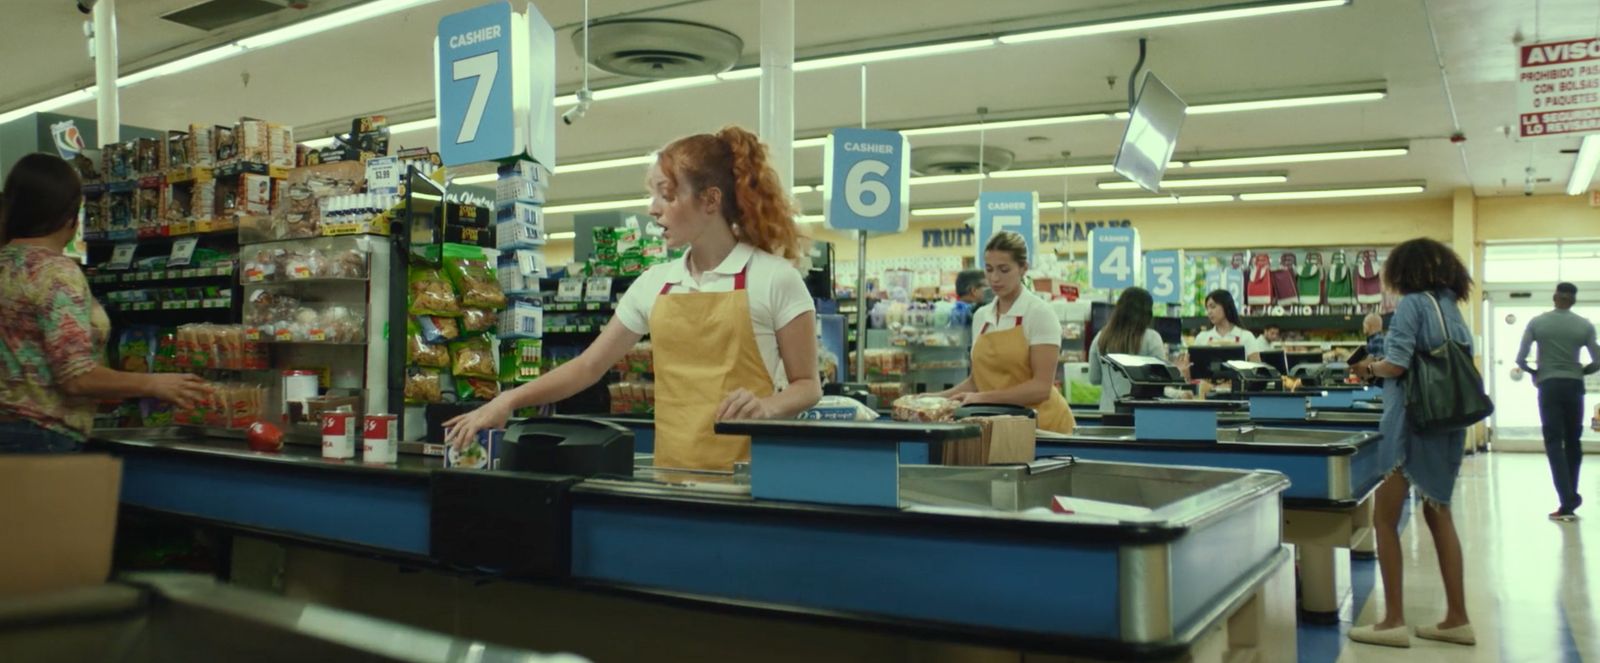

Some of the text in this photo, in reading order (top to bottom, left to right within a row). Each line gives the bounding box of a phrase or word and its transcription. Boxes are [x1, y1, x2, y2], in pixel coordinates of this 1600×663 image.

[450, 25, 501, 48] CASHIER
[1527, 42, 1600, 64] AVISO
[1521, 68, 1573, 81] PROHIBIDO
[1533, 80, 1598, 94] CON BOLSAS
[453, 50, 498, 144] 7
[1533, 98, 1541, 108] O
[1522, 115, 1539, 125] LA
[1526, 124, 1544, 135] LO
[844, 142, 893, 154] CASHIER
[845, 159, 891, 217] 6
[987, 201, 1026, 211] CASHIER
[1099, 246, 1131, 281] 4
[1152, 266, 1174, 296] 3
